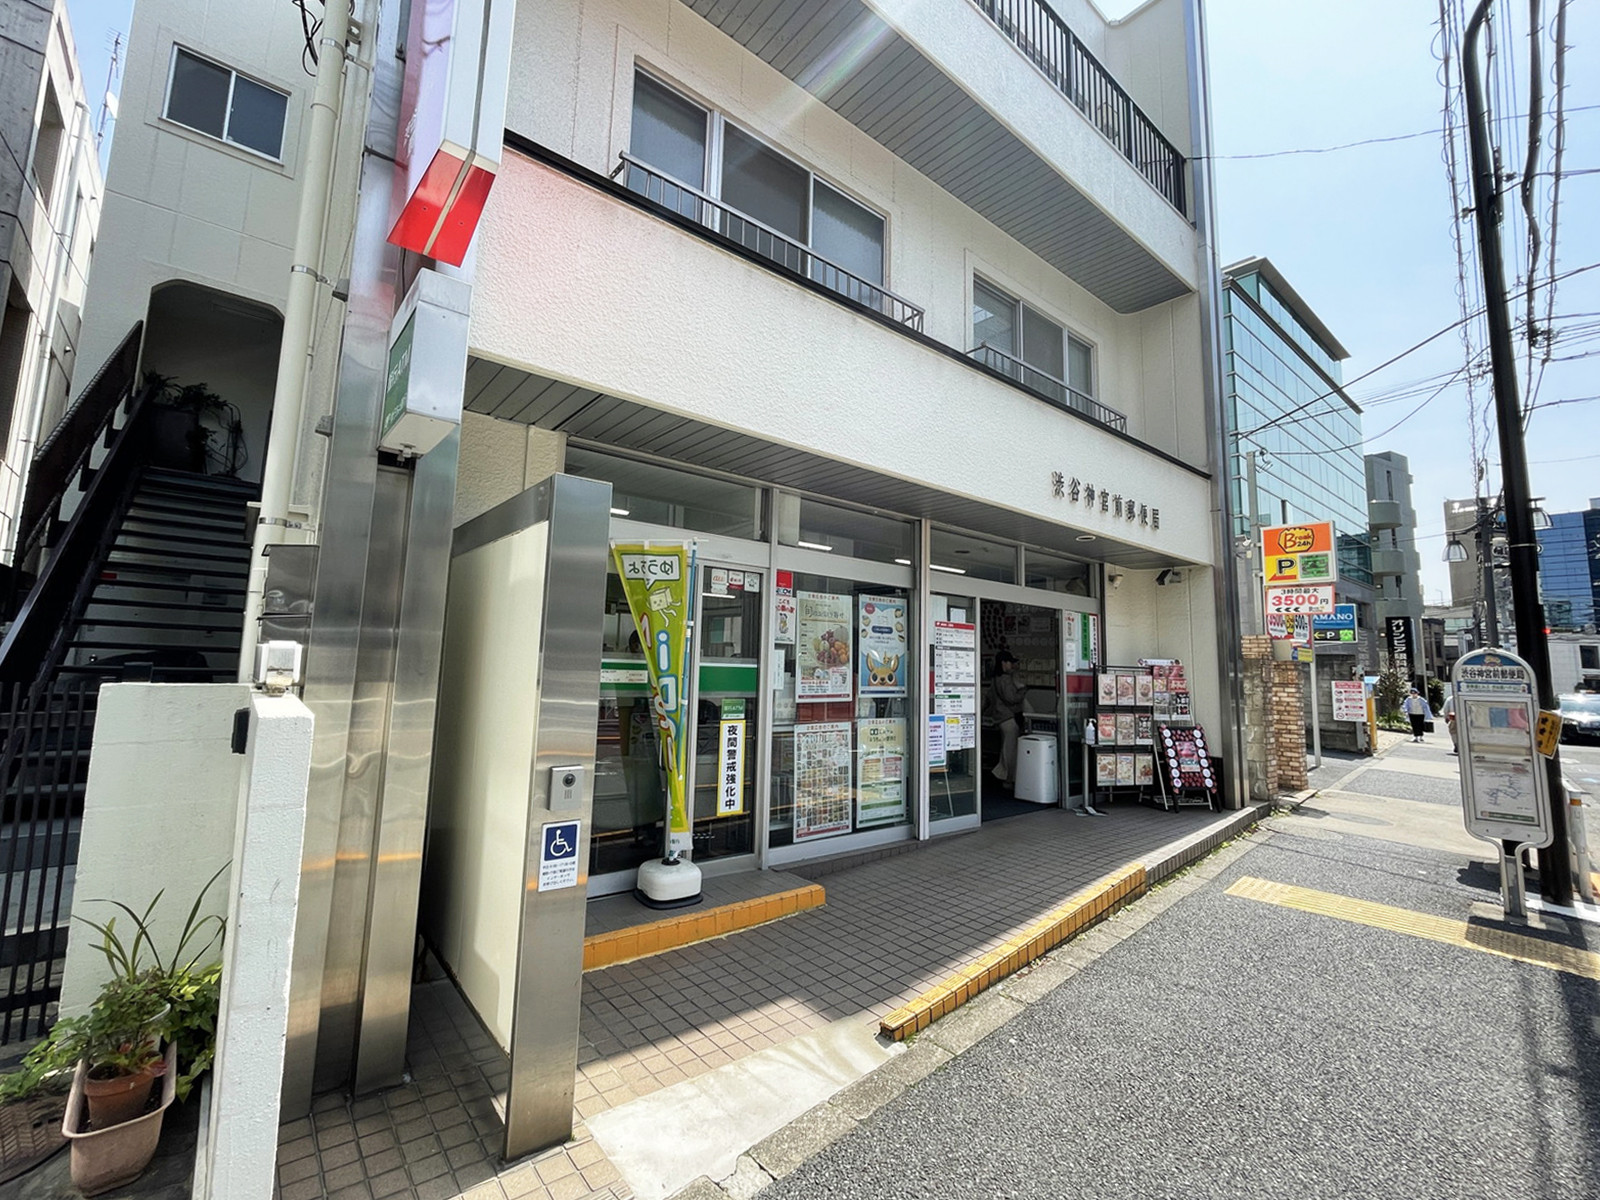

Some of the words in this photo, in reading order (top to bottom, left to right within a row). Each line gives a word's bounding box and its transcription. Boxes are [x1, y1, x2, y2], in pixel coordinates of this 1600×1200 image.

[1052, 471, 1160, 530] 渋谷神宮前郵便局
[1283, 532, 1312, 549] Break
[1277, 559, 1295, 574] P
[1313, 613, 1353, 621] AMANO
[1326, 631, 1335, 639] P
[1461, 666, 1525, 680] 渋谷神宮前郵便局
[725, 725, 738, 810] 夜間警戒強化中
